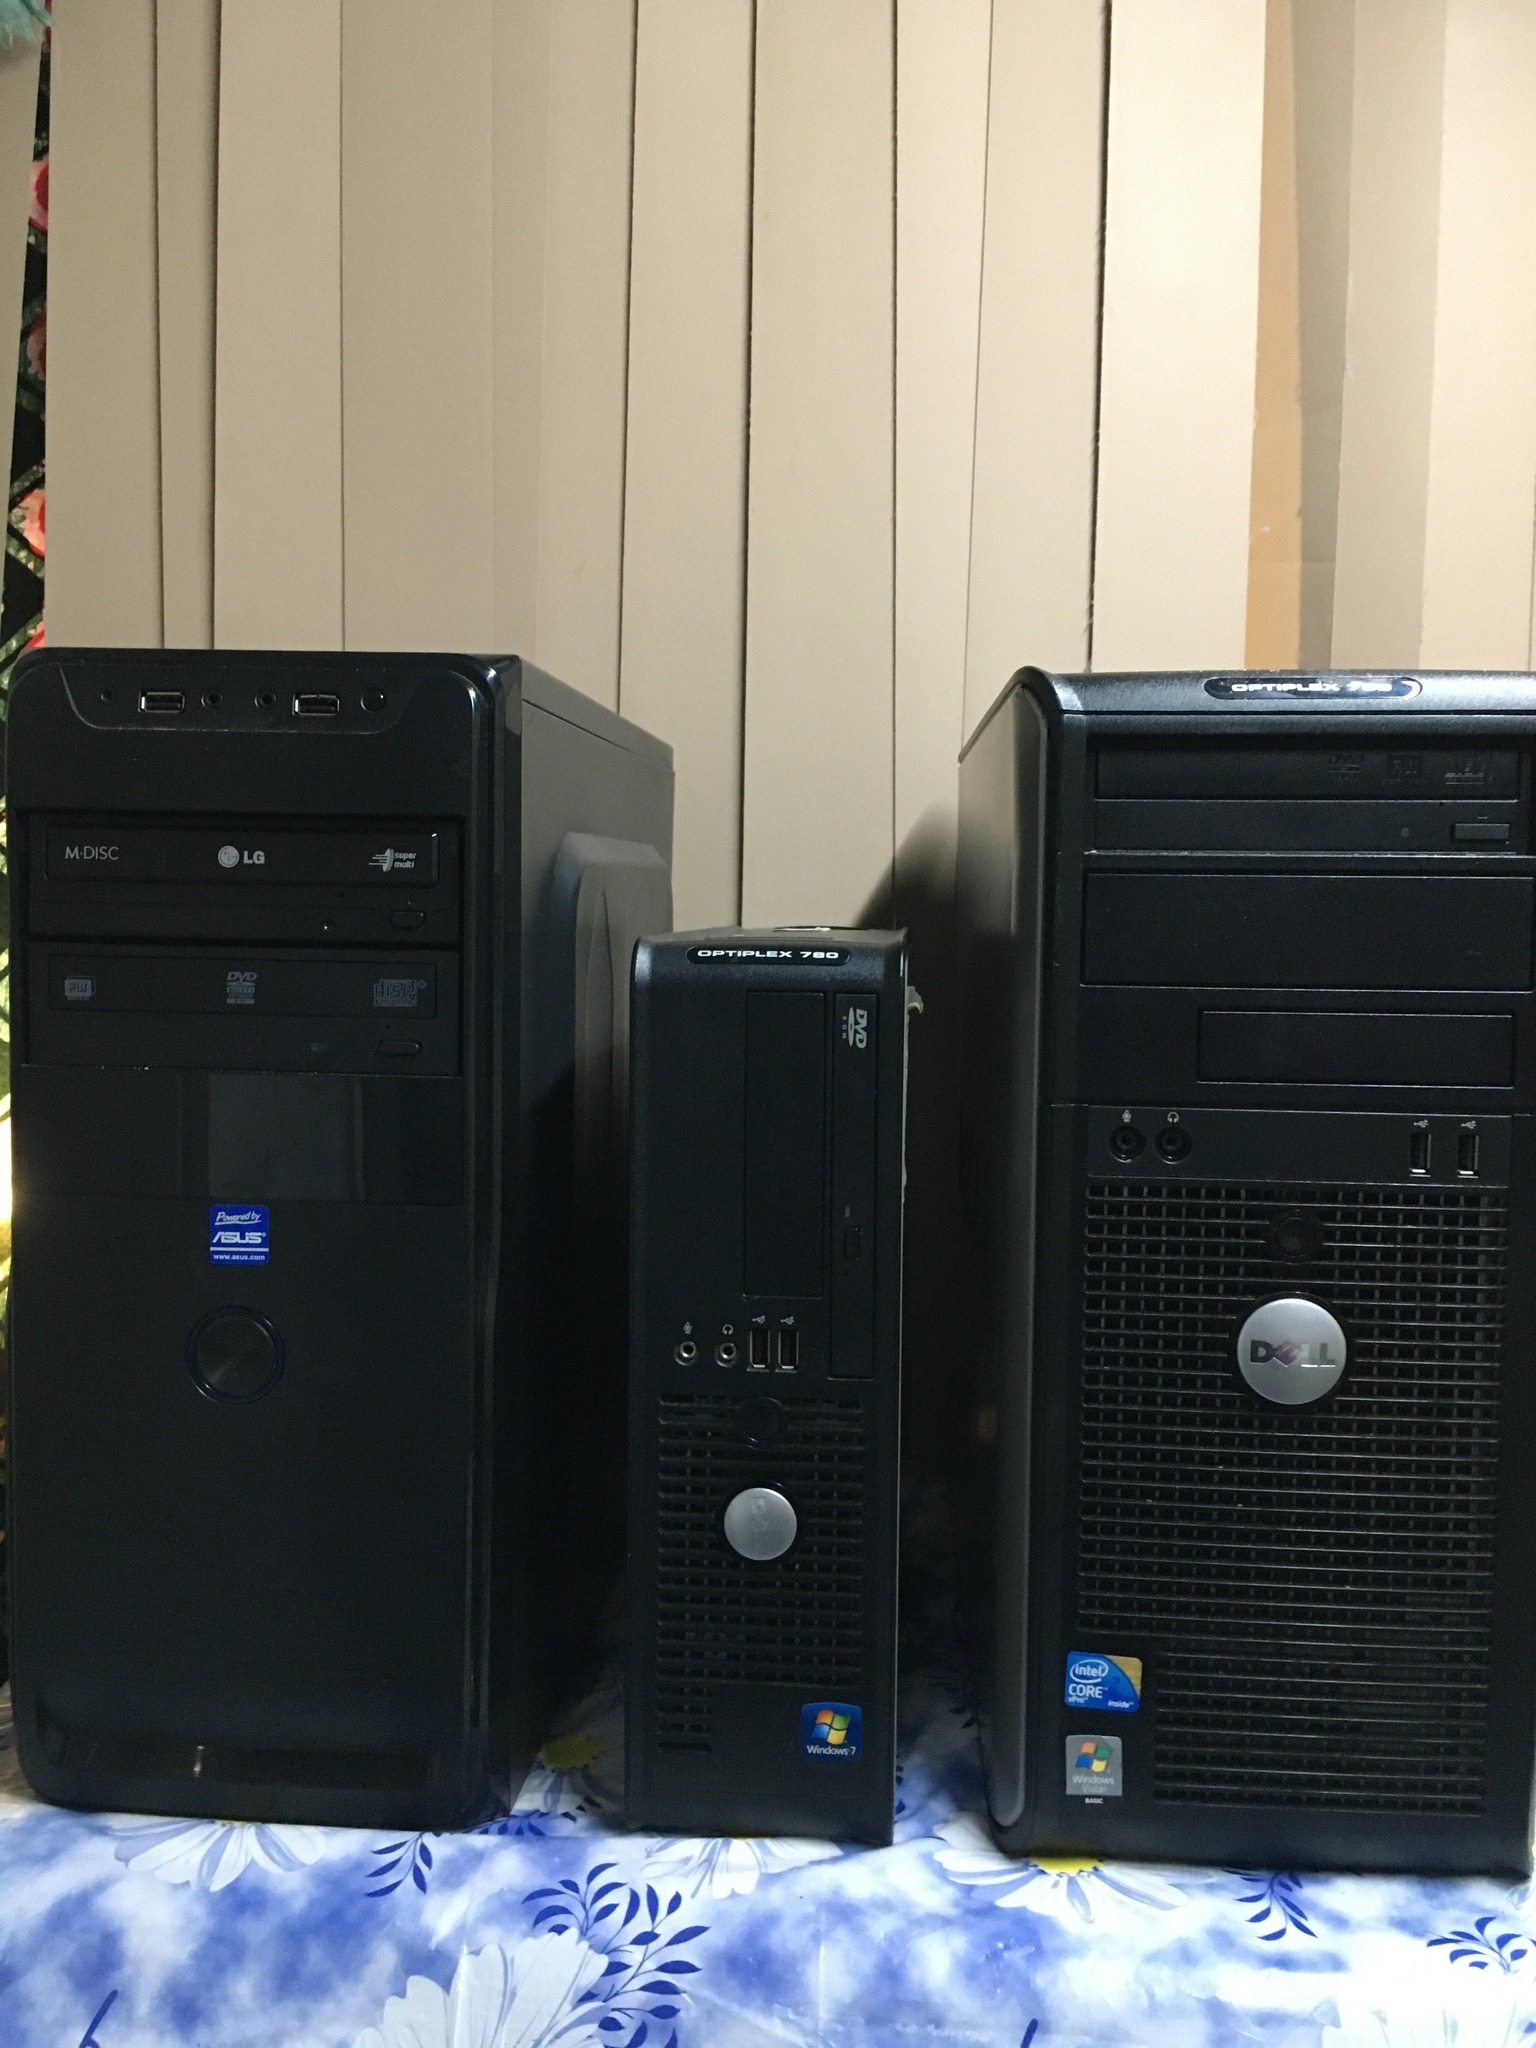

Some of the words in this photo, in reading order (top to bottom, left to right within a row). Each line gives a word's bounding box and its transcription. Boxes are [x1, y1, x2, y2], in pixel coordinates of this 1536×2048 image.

[1231, 683, 1340, 692] OPTIPLEX
[243, 850, 266, 865] LG
[394, 852, 417, 861] super
[394, 860, 416, 869] multi
[697, 949, 793, 958] OPTIPLEX
[799, 950, 840, 960] 780
[226, 971, 258, 982] DVD
[854, 1008, 868, 1049] DVD
[215, 1211, 252, 1223] Powered
[251, 1210, 262, 1222] by
[1068, 1683, 1104, 1699] CORE
[806, 1744, 849, 1756] Windows
[849, 1746, 857, 1756] 7
[1071, 1774, 1115, 1785] Windows
